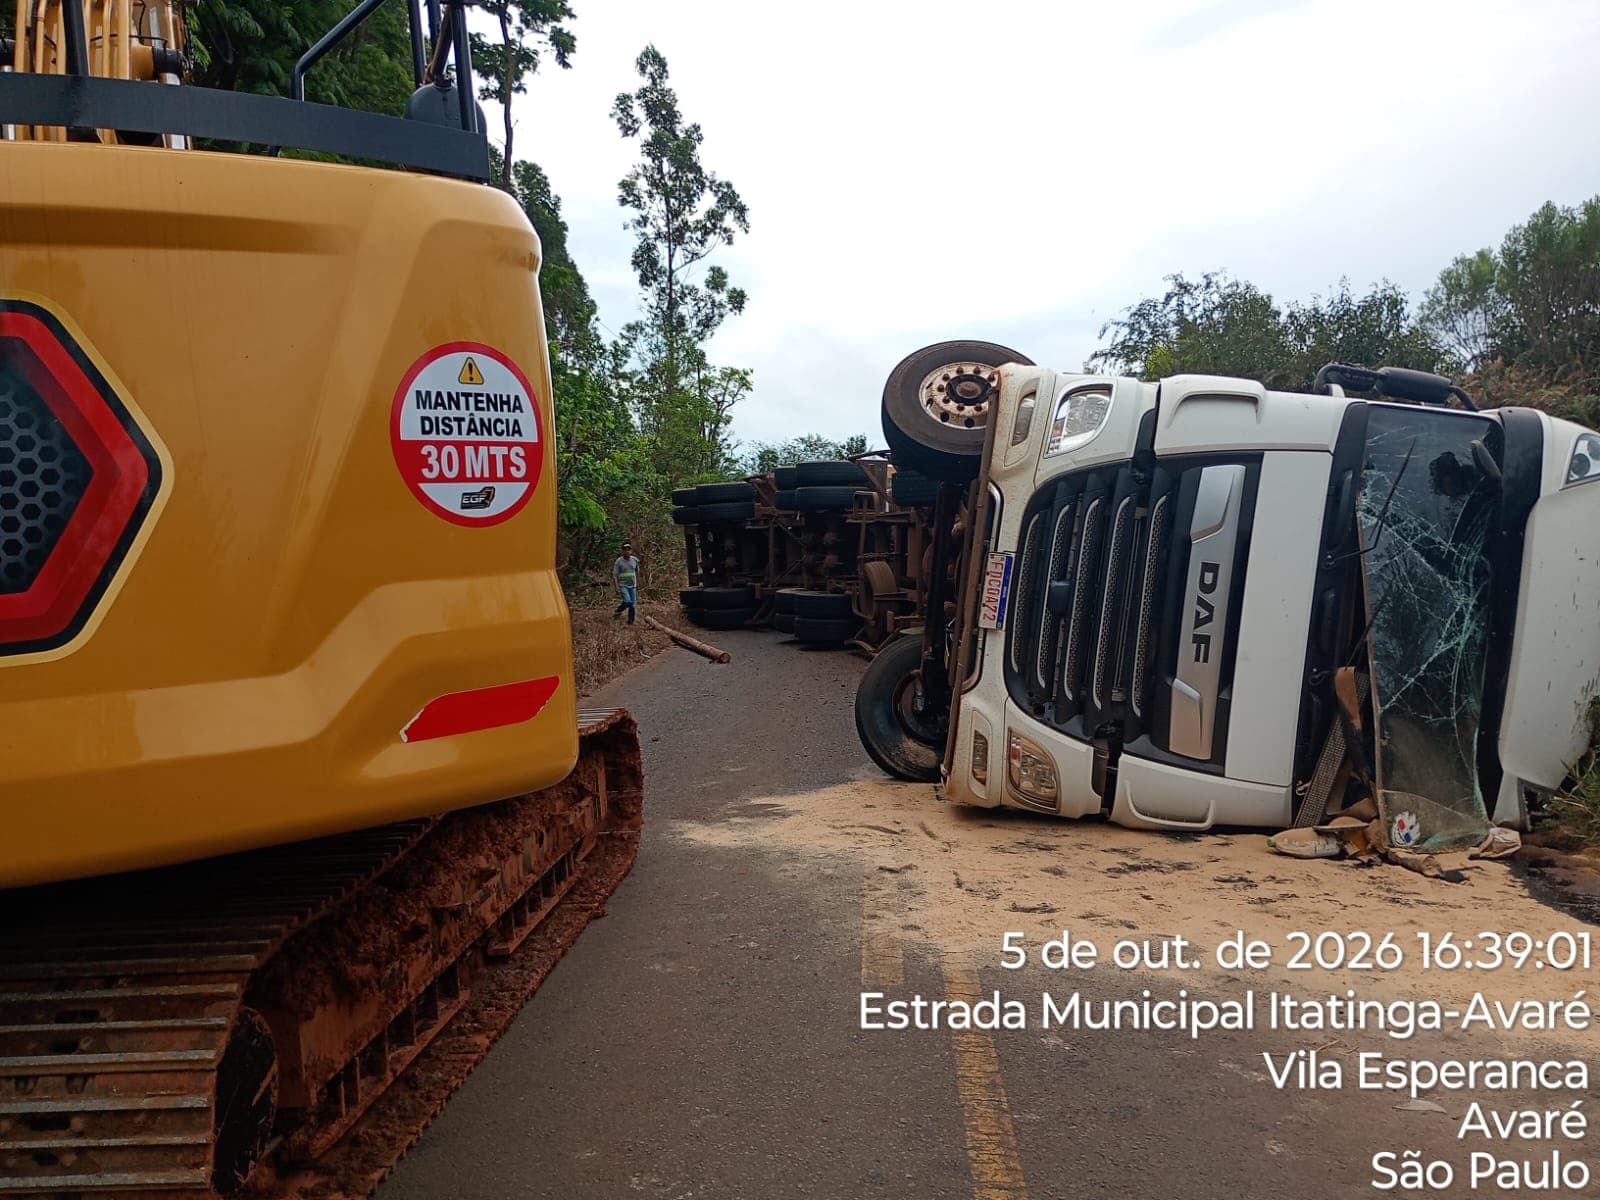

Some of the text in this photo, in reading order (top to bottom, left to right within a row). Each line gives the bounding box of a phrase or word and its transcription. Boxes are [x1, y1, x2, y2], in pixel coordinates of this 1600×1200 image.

[415, 390, 523, 413] MANTENHA
[420, 412, 522, 437] DISTÂNCIA
[420, 445, 526, 479] 30 MTS
[1192, 561, 1220, 663] DAF
